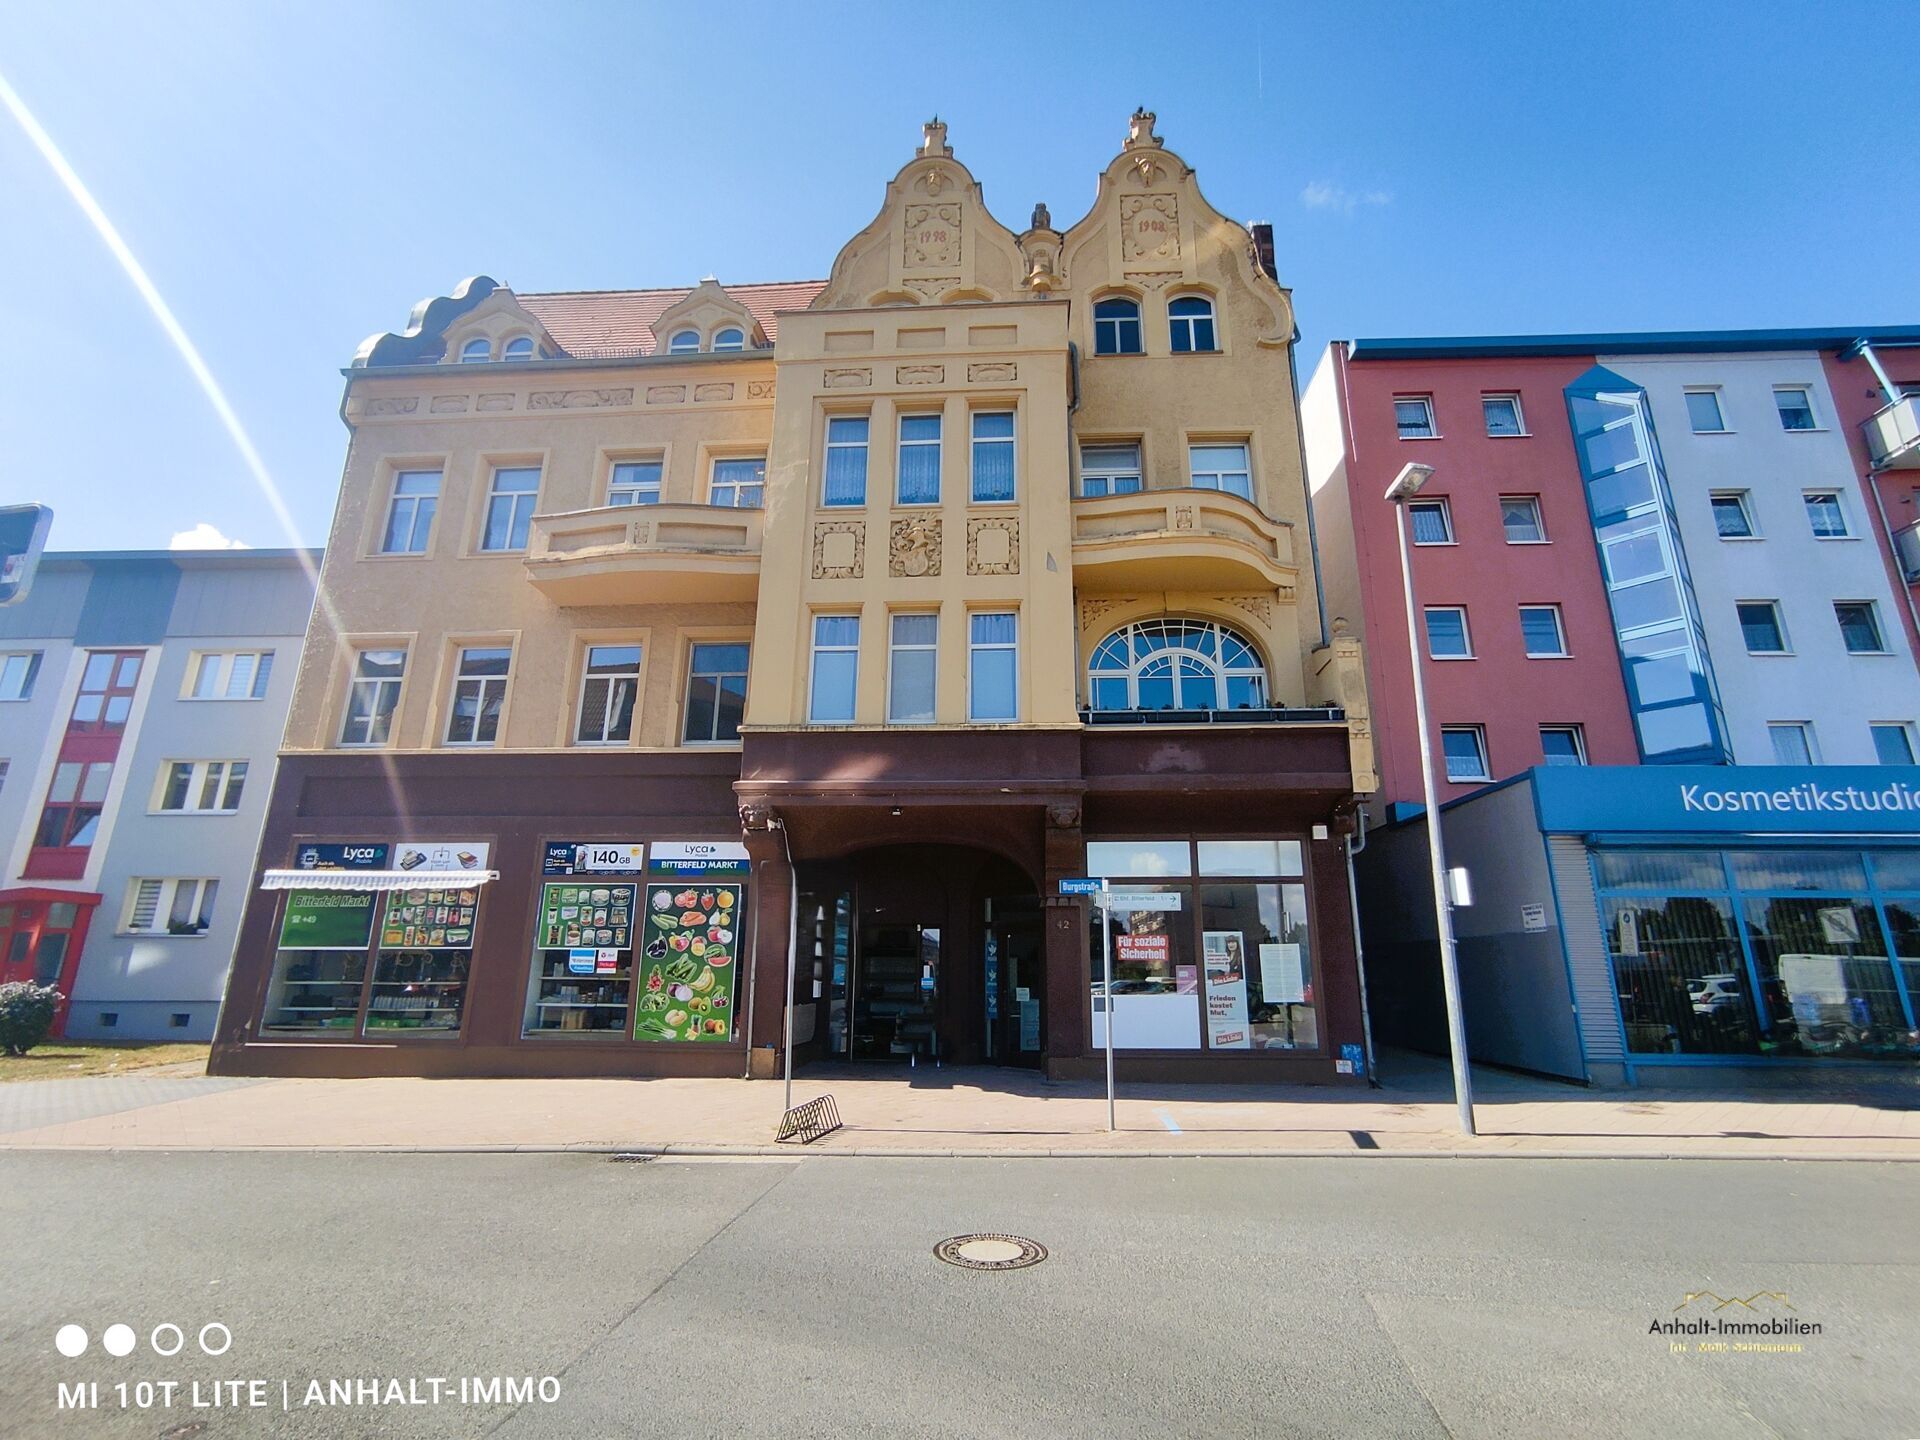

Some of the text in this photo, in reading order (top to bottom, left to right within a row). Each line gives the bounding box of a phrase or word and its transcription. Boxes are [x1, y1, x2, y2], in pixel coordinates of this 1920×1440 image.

[343, 846, 375, 860] Lyca
[549, 847, 567, 856] Lyca
[685, 844, 709, 854] Lyca
[593, 851, 618, 864] 140
[661, 861, 739, 869] BITTERFELD MARKT
[294, 895, 372, 907] Bitterfeld Markt
[1057, 920, 1070, 929] 42
[1118, 936, 1166, 947] Für soziale
[1120, 948, 1166, 959] Sicherheit
